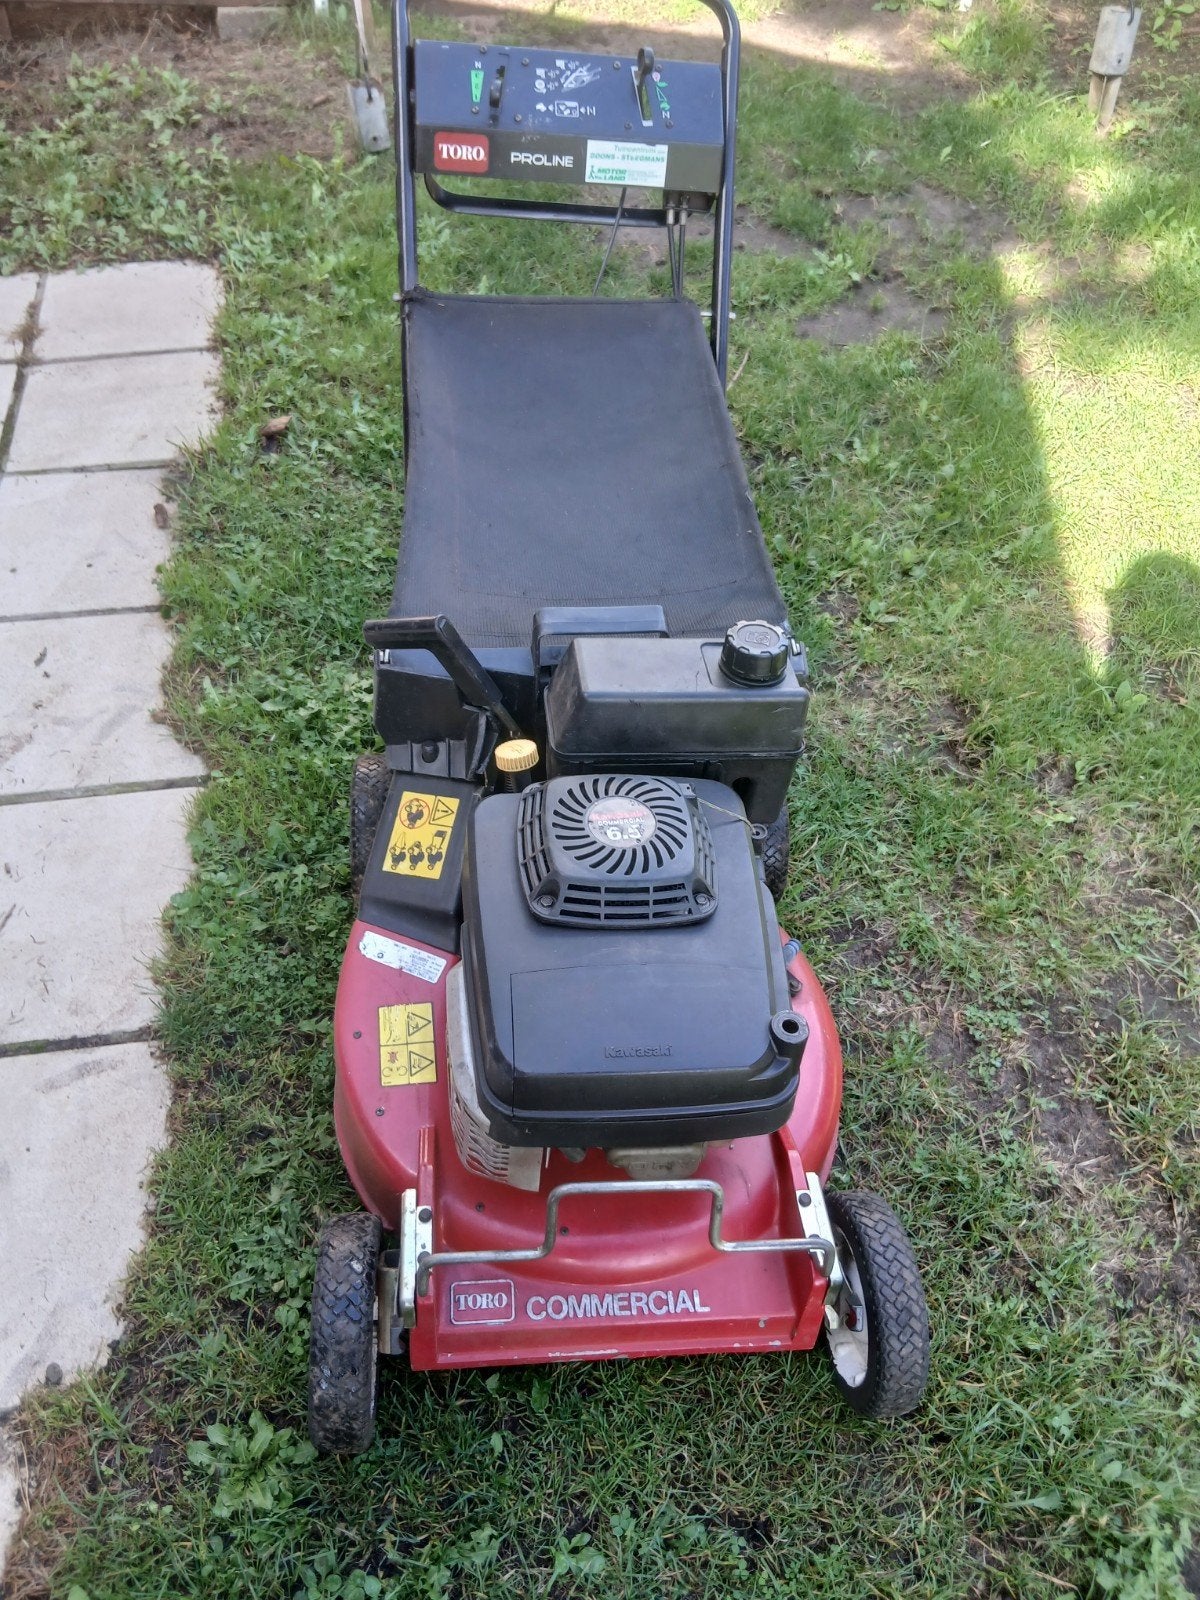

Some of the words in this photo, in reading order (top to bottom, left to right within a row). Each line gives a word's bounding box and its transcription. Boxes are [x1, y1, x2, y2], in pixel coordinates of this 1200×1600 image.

[474, 60, 482, 69] N
[661, 110, 671, 119] N
[438, 143, 485, 162] TORO
[510, 152, 574, 168] PROLINE
[598, 817, 645, 827] COMMERCIAL
[604, 1044, 673, 1059] Kawasaki
[456, 1292, 508, 1311] TORO
[526, 1289, 711, 1321] COMMERCIAL
